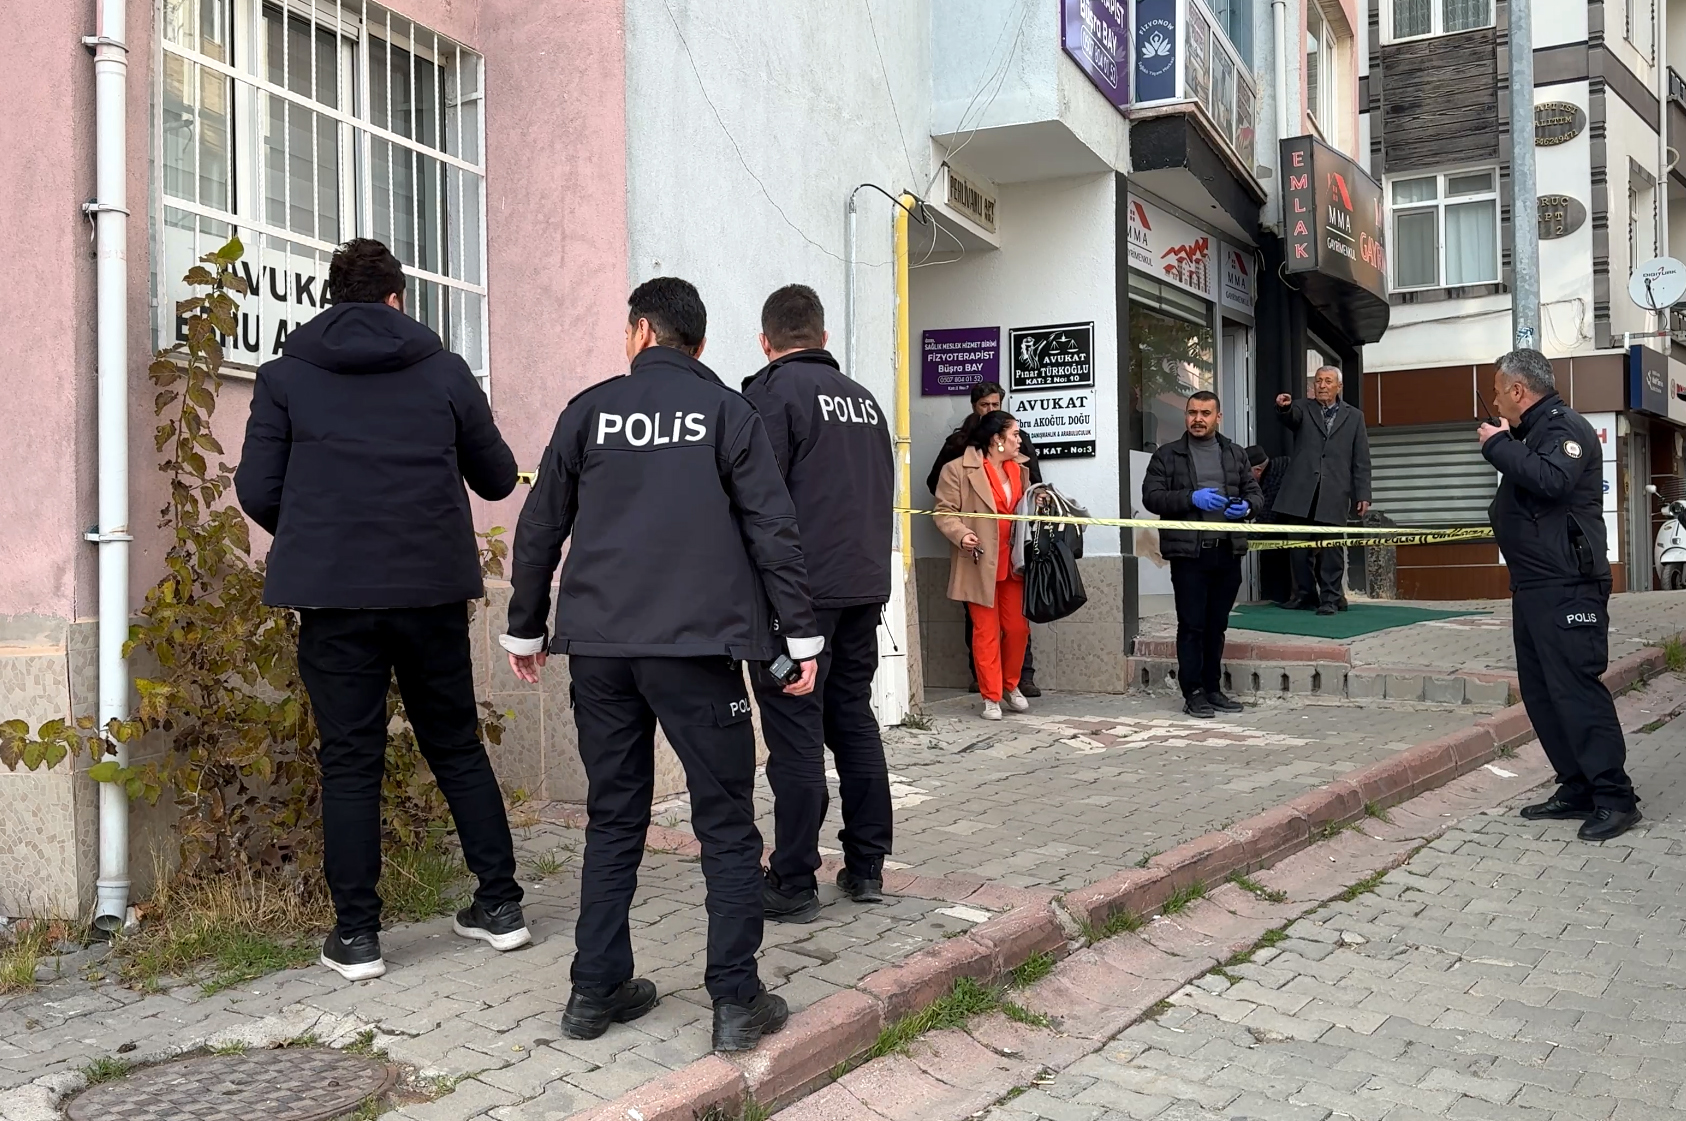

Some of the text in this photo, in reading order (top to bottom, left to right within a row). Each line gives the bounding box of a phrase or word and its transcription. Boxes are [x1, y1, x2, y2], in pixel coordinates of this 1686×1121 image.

[1103, 20, 1117, 56] BAY
[1534, 116, 1572, 127] ALITIM
[1289, 151, 1309, 259] EMLAK
[1328, 204, 1351, 233] MMA
[1556, 225, 1564, 235] 2
[1227, 271, 1246, 290] MMA
[942, 342, 961, 350] MESLEK
[962, 341, 980, 349] HİZMET
[928, 350, 994, 362] FİZYOTERAPİST
[1043, 353, 1086, 364] AVUKAT
[938, 363, 983, 374] Büşra BAY
[1016, 363, 1089, 378] Pınar TÜRKOĞLU
[1016, 396, 1088, 412] AVUKAT
[1033, 414, 1066, 428] AKOĞUL
[1068, 413, 1090, 426] DOĞU
[1035, 448, 1041, 456] Ş
[1043, 447, 1062, 455] KAT
[1070, 446, 1093, 454] No:3
[729, 698, 751, 717] POL
